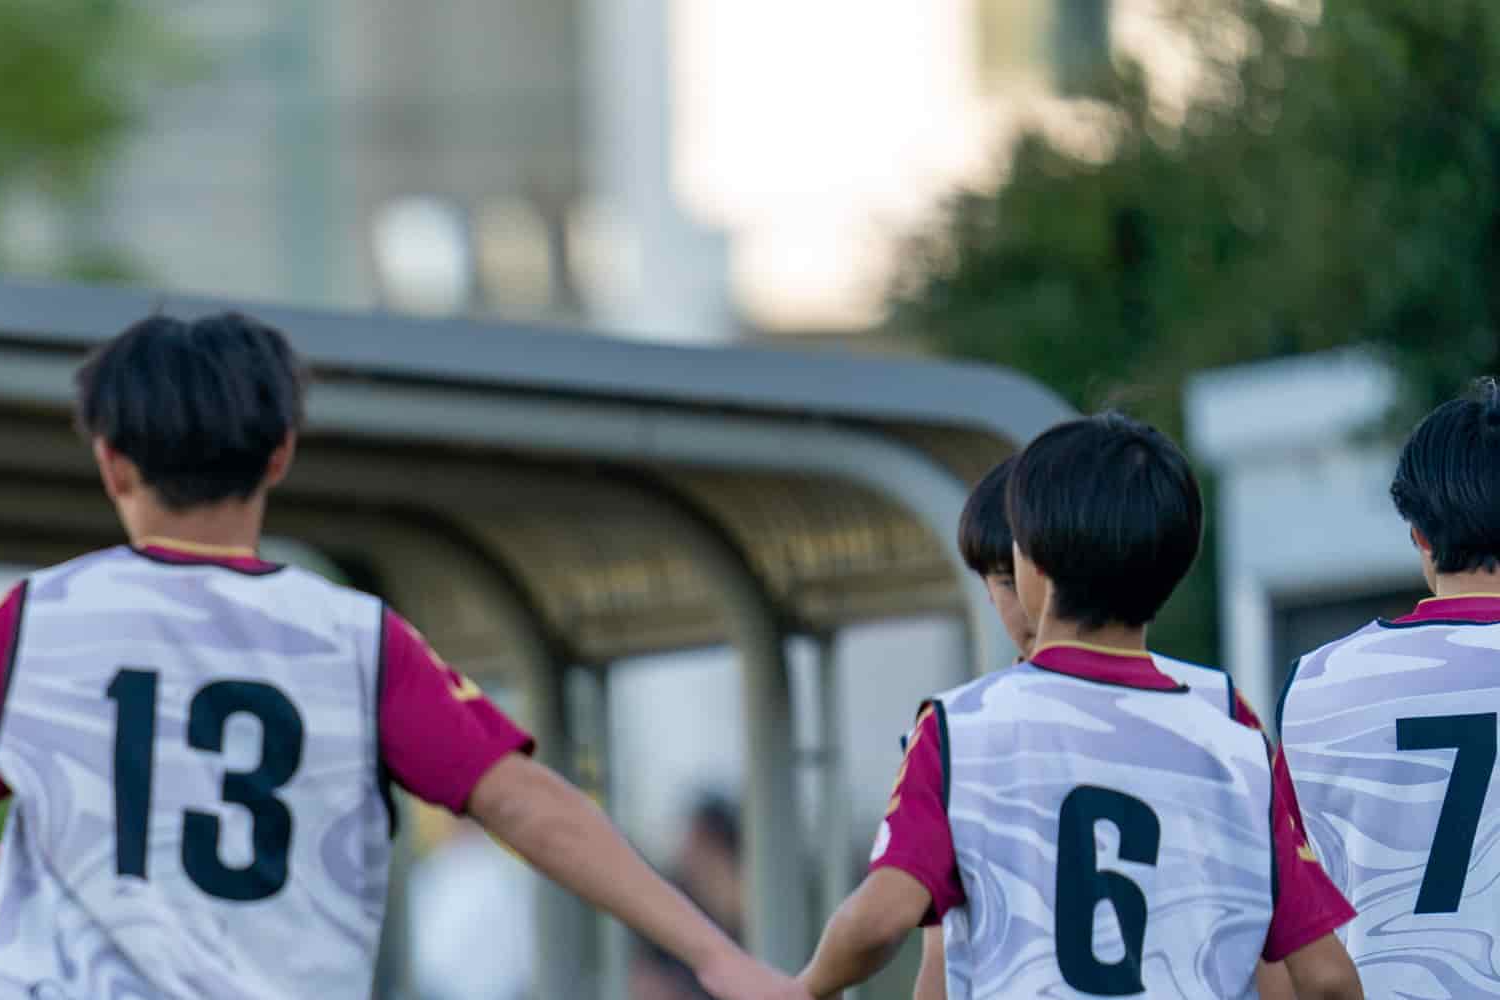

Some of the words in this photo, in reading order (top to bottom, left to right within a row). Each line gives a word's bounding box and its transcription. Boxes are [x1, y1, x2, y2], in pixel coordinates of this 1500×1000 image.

[106, 668, 305, 902] 13
[1054, 784, 1161, 997] 6
[1395, 711, 1498, 915] 7
